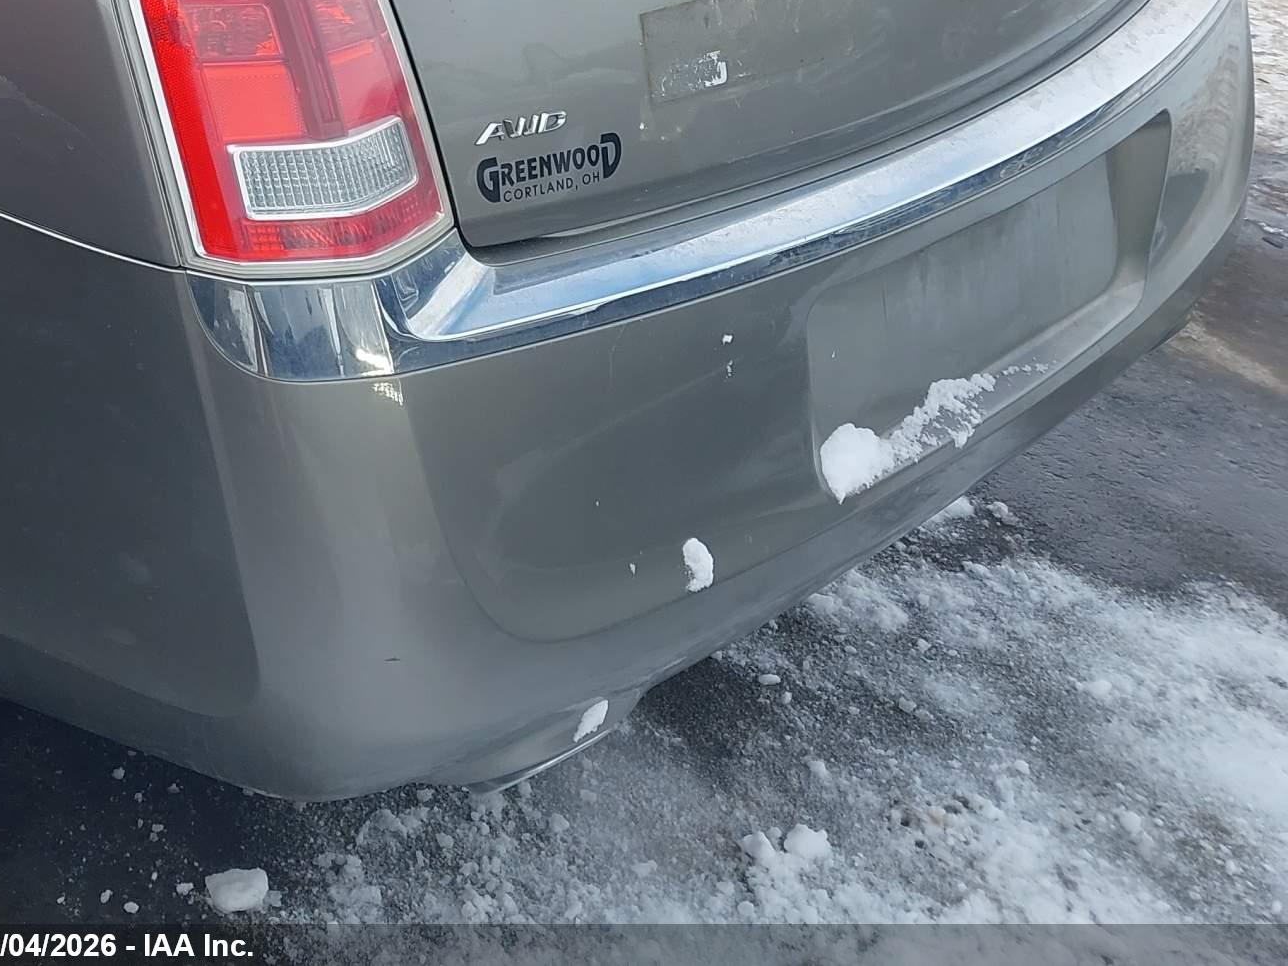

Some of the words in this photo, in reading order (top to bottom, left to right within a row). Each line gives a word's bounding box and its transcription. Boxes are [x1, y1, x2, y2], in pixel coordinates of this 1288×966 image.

[474, 110, 567, 146] AWD
[503, 176, 578, 203] CORTLAND,
[582, 170, 600, 185] OH
